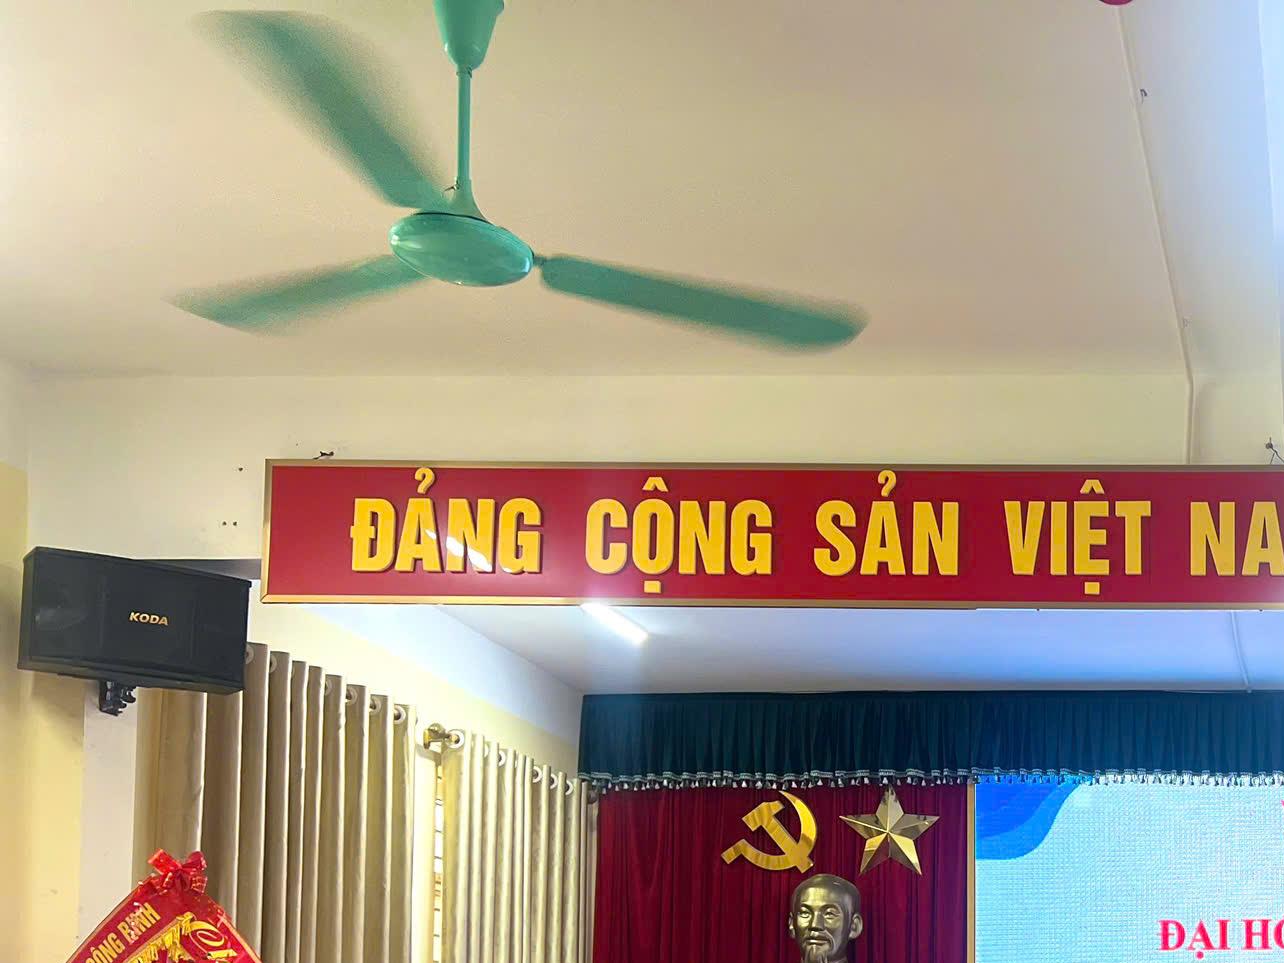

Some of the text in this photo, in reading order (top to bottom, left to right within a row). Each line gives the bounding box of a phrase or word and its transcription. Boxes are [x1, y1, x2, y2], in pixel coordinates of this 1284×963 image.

[350, 467, 542, 574] ĐẢNG
[586, 477, 773, 593] CỘNG
[813, 469, 960, 576] SẢN
[1004, 479, 1152, 594] VIỆT
[129, 611, 169, 626] KODA
[1158, 919, 1231, 960] ĐẠI
